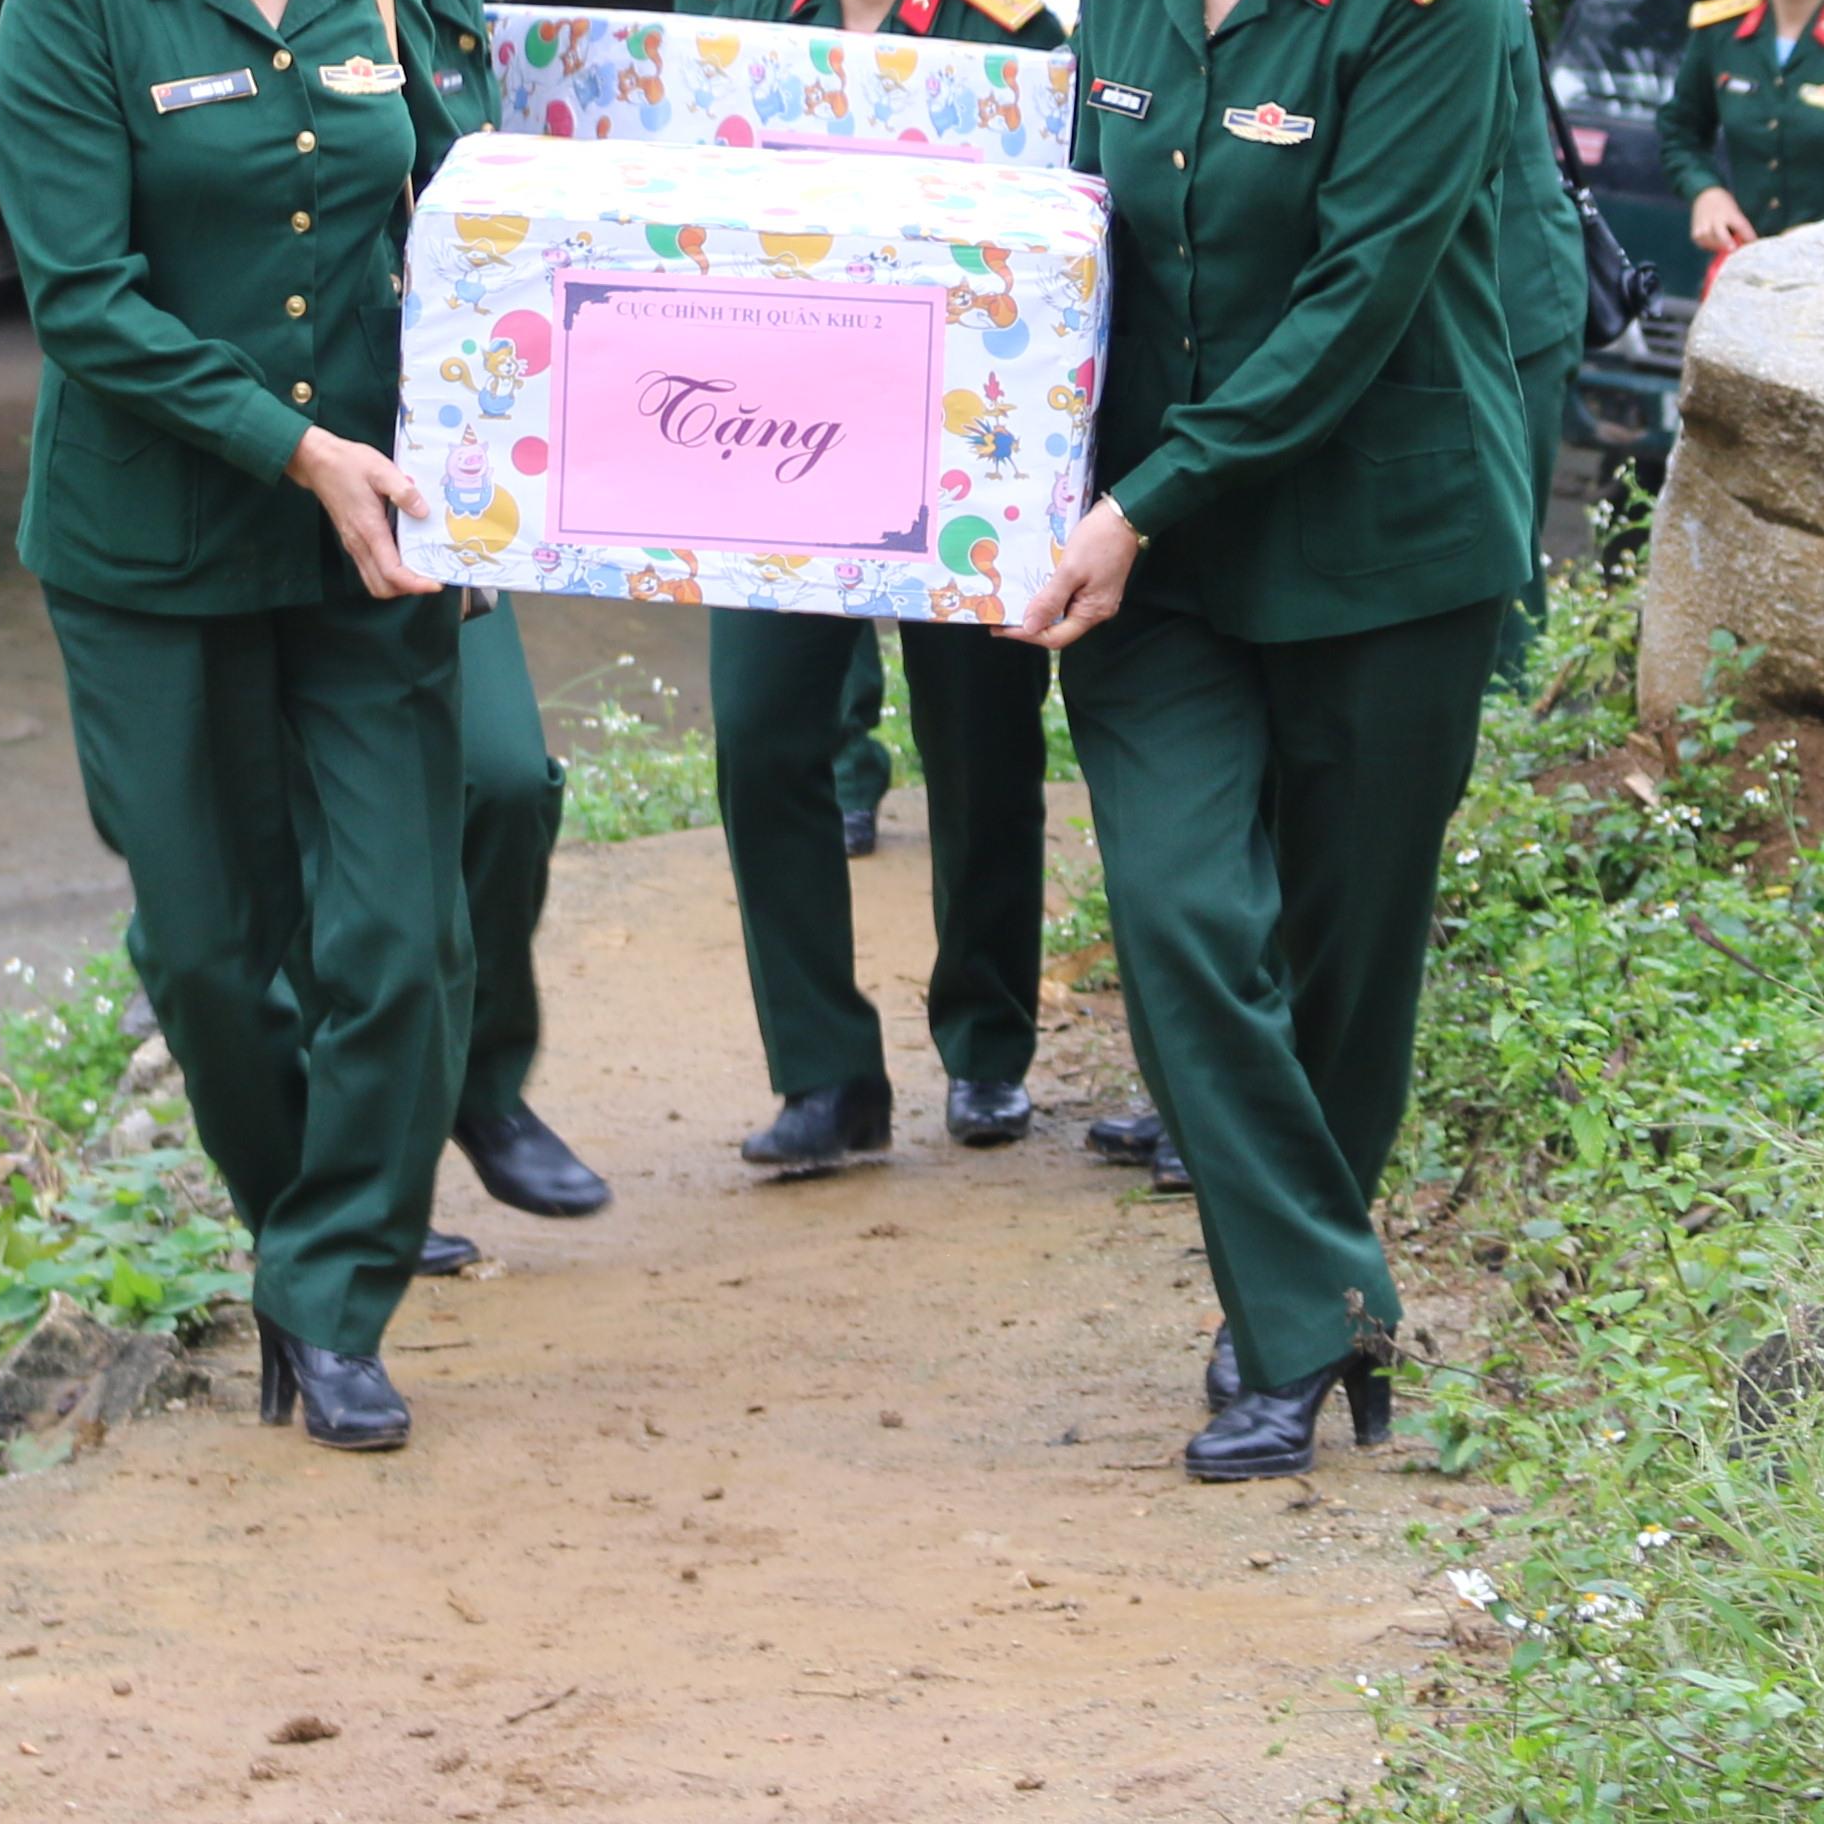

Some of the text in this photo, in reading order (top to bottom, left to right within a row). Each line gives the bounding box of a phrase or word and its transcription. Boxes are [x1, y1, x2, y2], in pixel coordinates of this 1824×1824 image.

[616, 301, 656, 320] CỤC
[661, 302, 723, 321] CHÍNH
[729, 306, 761, 326] TRỊ
[828, 312, 869, 329] KHU
[873, 315, 882, 329] 2
[635, 369, 847, 484] Tặng
